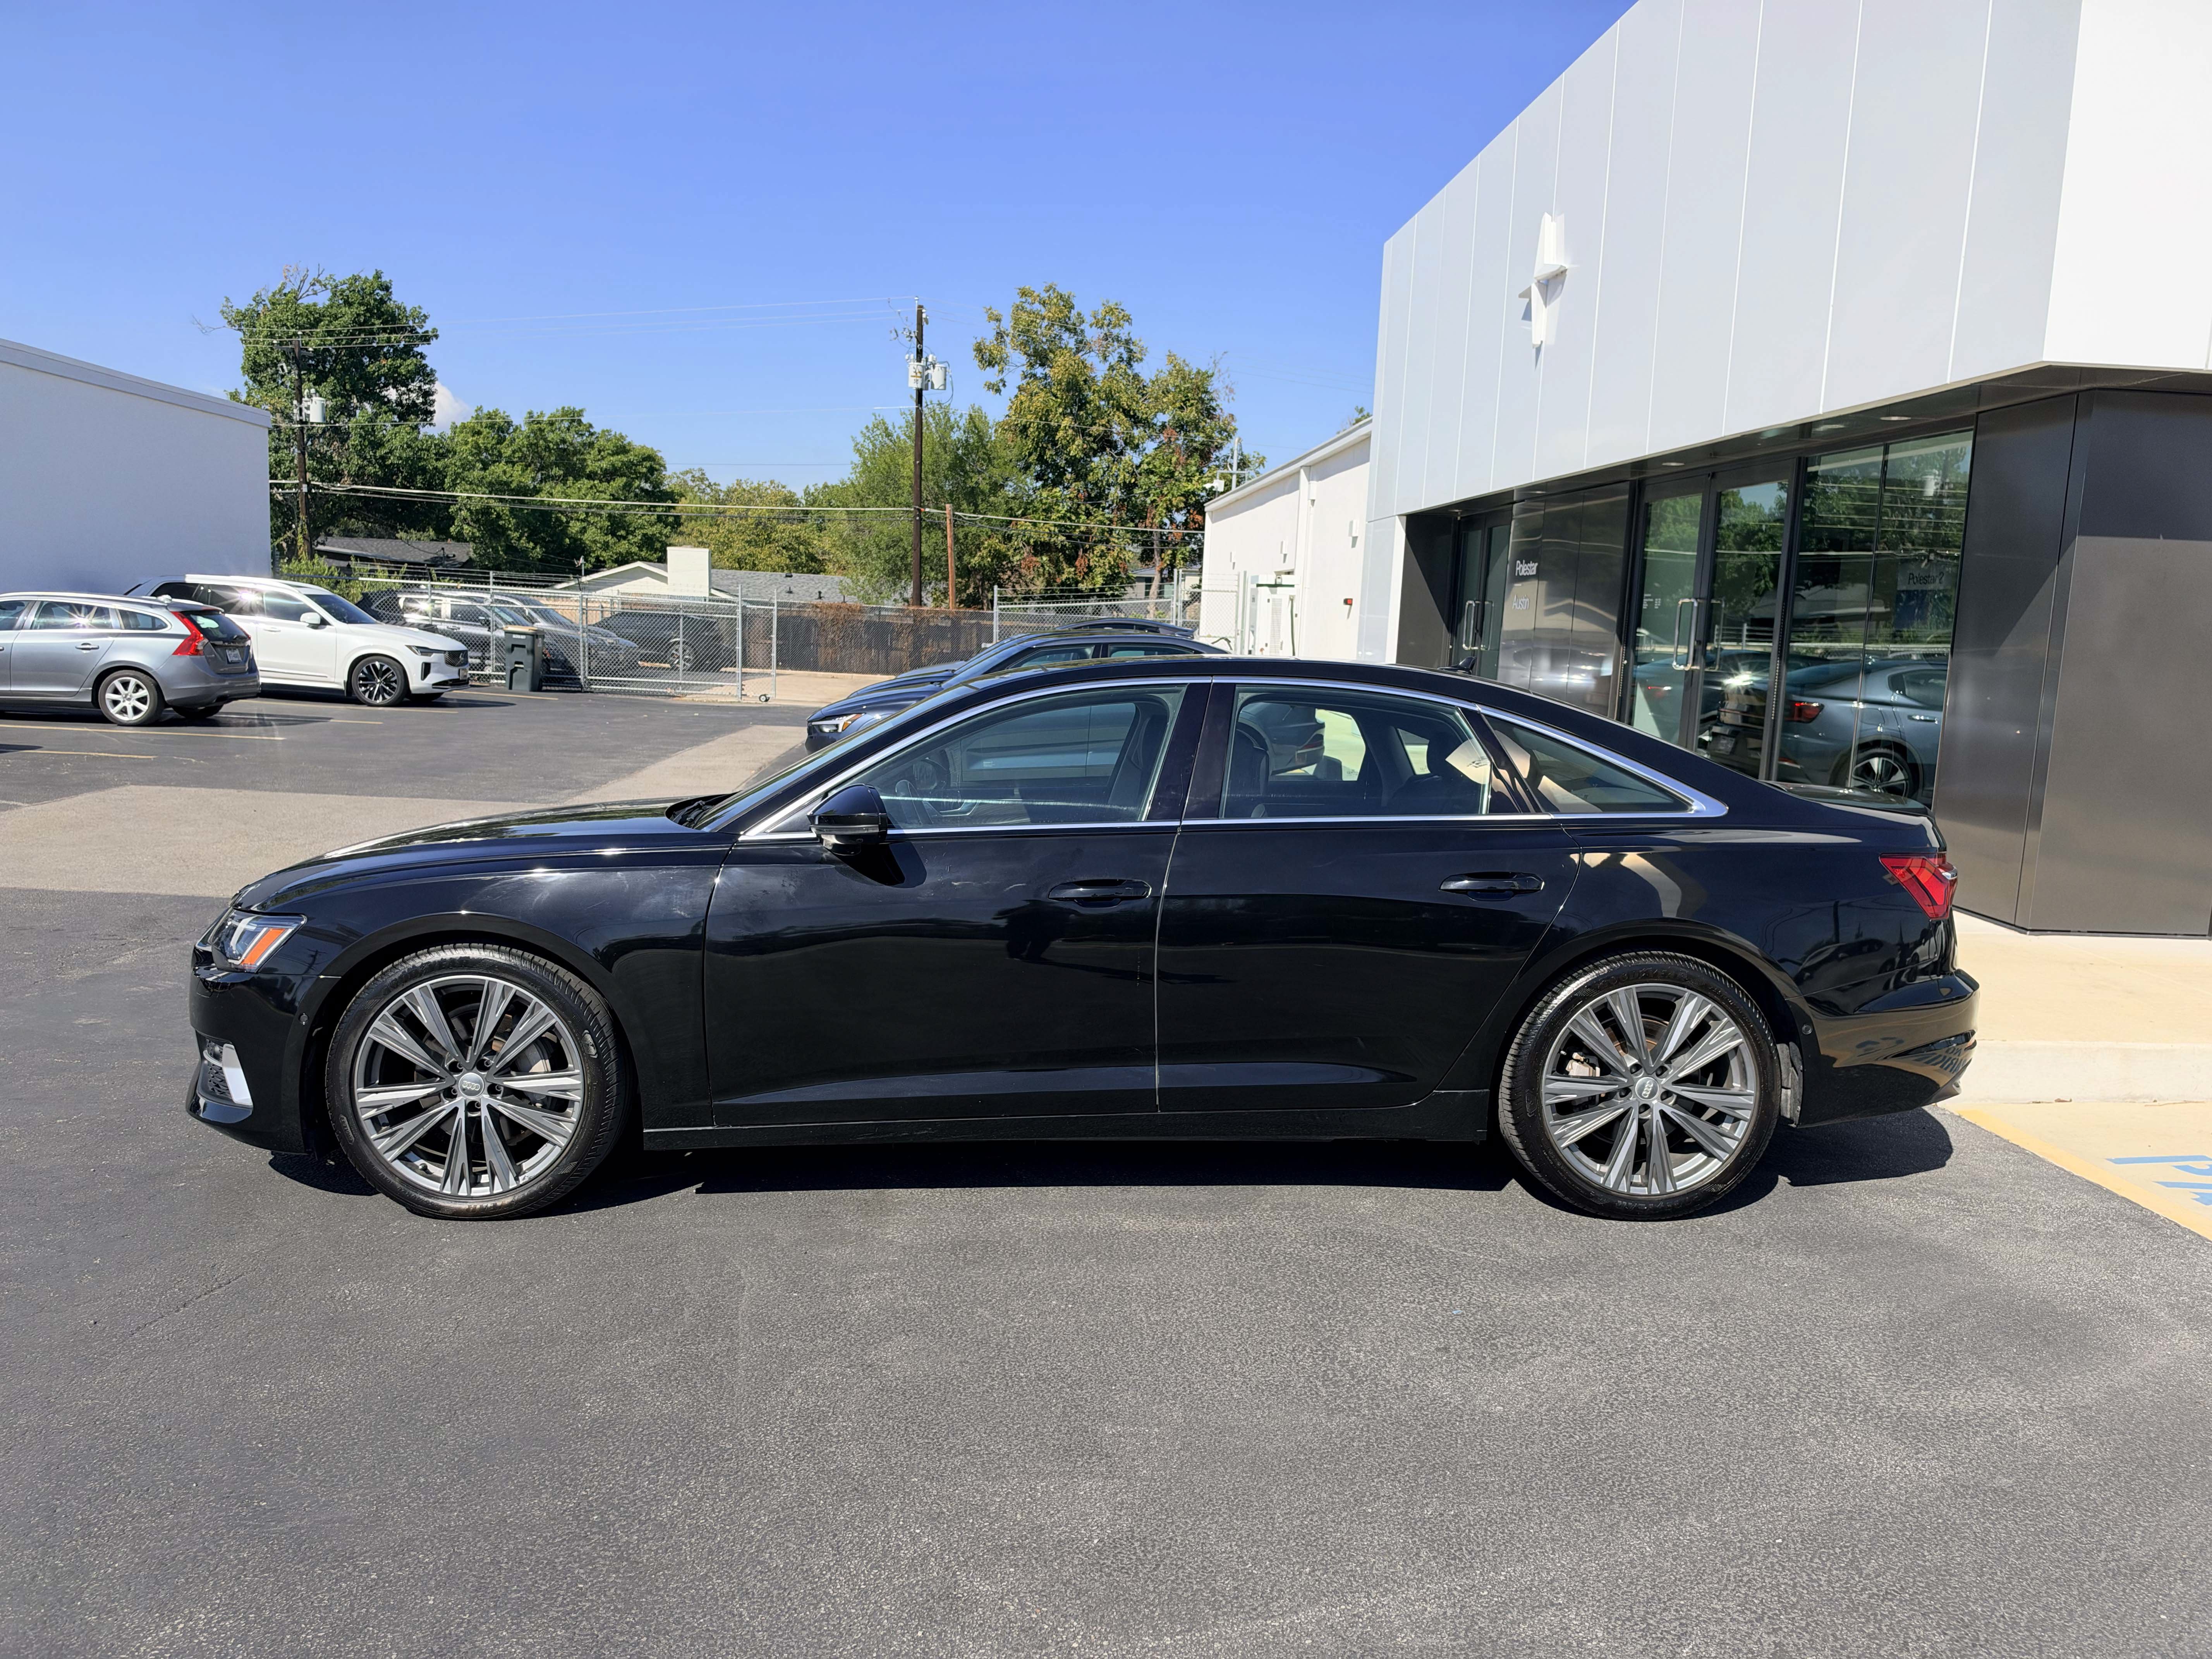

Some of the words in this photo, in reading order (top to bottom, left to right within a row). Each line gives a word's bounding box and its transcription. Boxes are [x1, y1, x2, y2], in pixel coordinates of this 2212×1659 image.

[1515, 560, 1538, 576] Polestar
[1908, 572, 1938, 585] Polestar
[1939, 571, 1944, 584] 2
[1512, 594, 1530, 610] Austin
